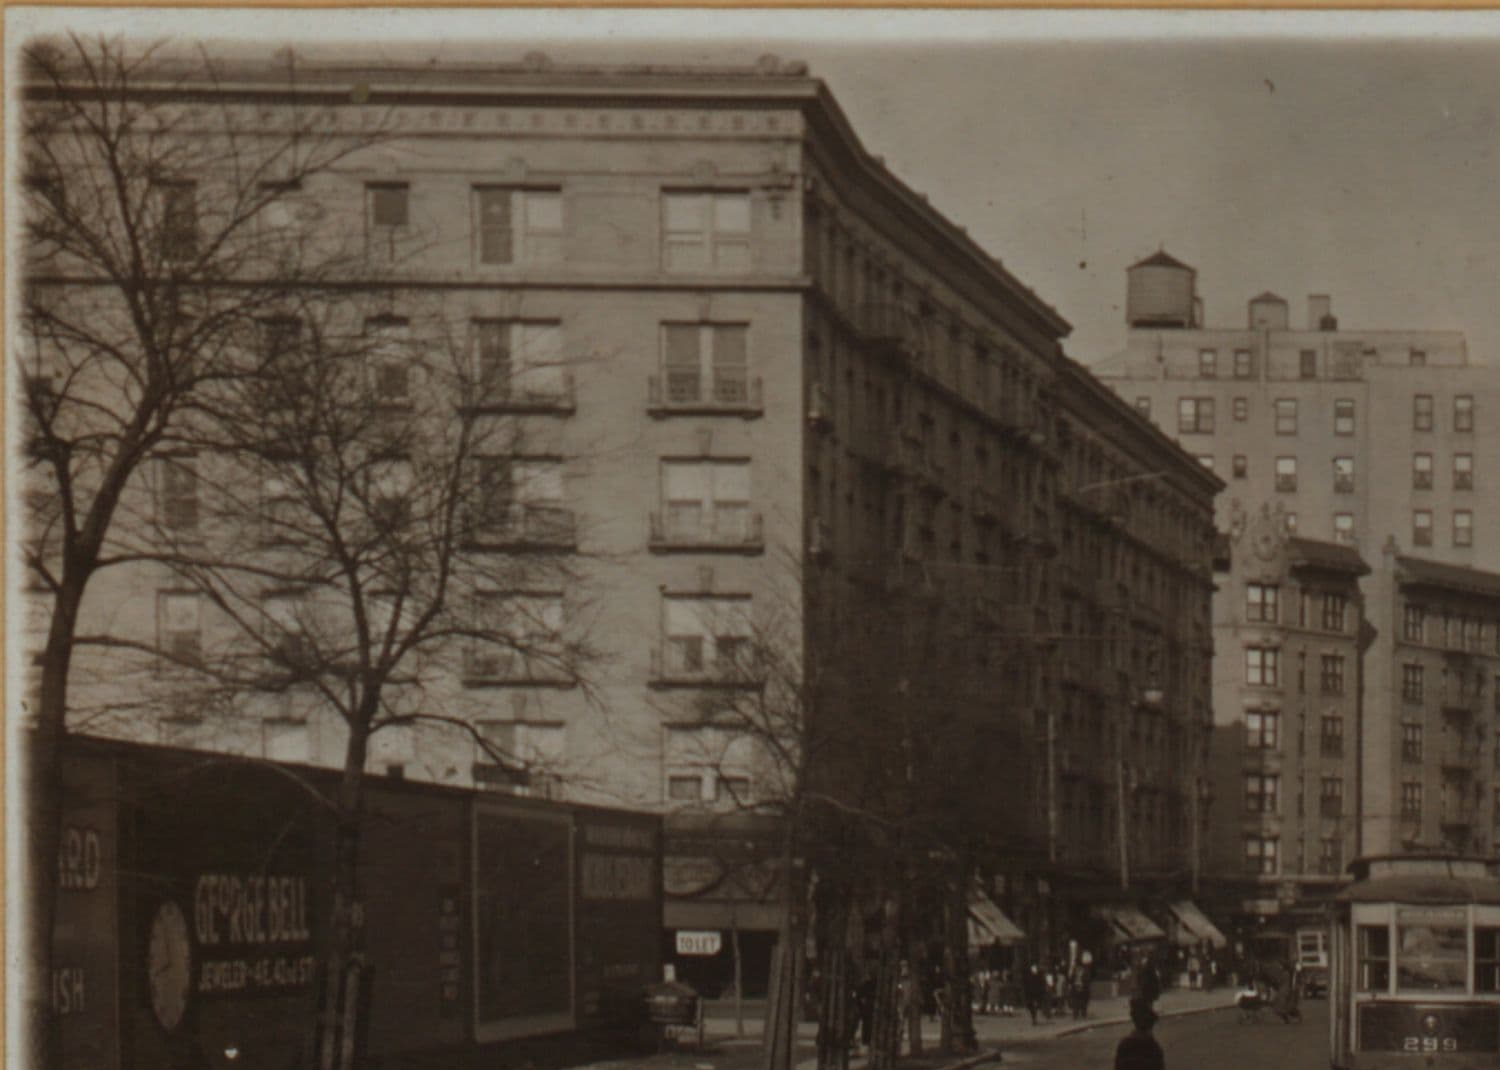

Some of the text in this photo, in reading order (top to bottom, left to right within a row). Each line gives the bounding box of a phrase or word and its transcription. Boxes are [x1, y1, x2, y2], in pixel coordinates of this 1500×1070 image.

[195, 875, 310, 944] GEORGE BELL
[680, 935, 716, 949] TO LET
[1403, 1037, 1457, 1052] 299
